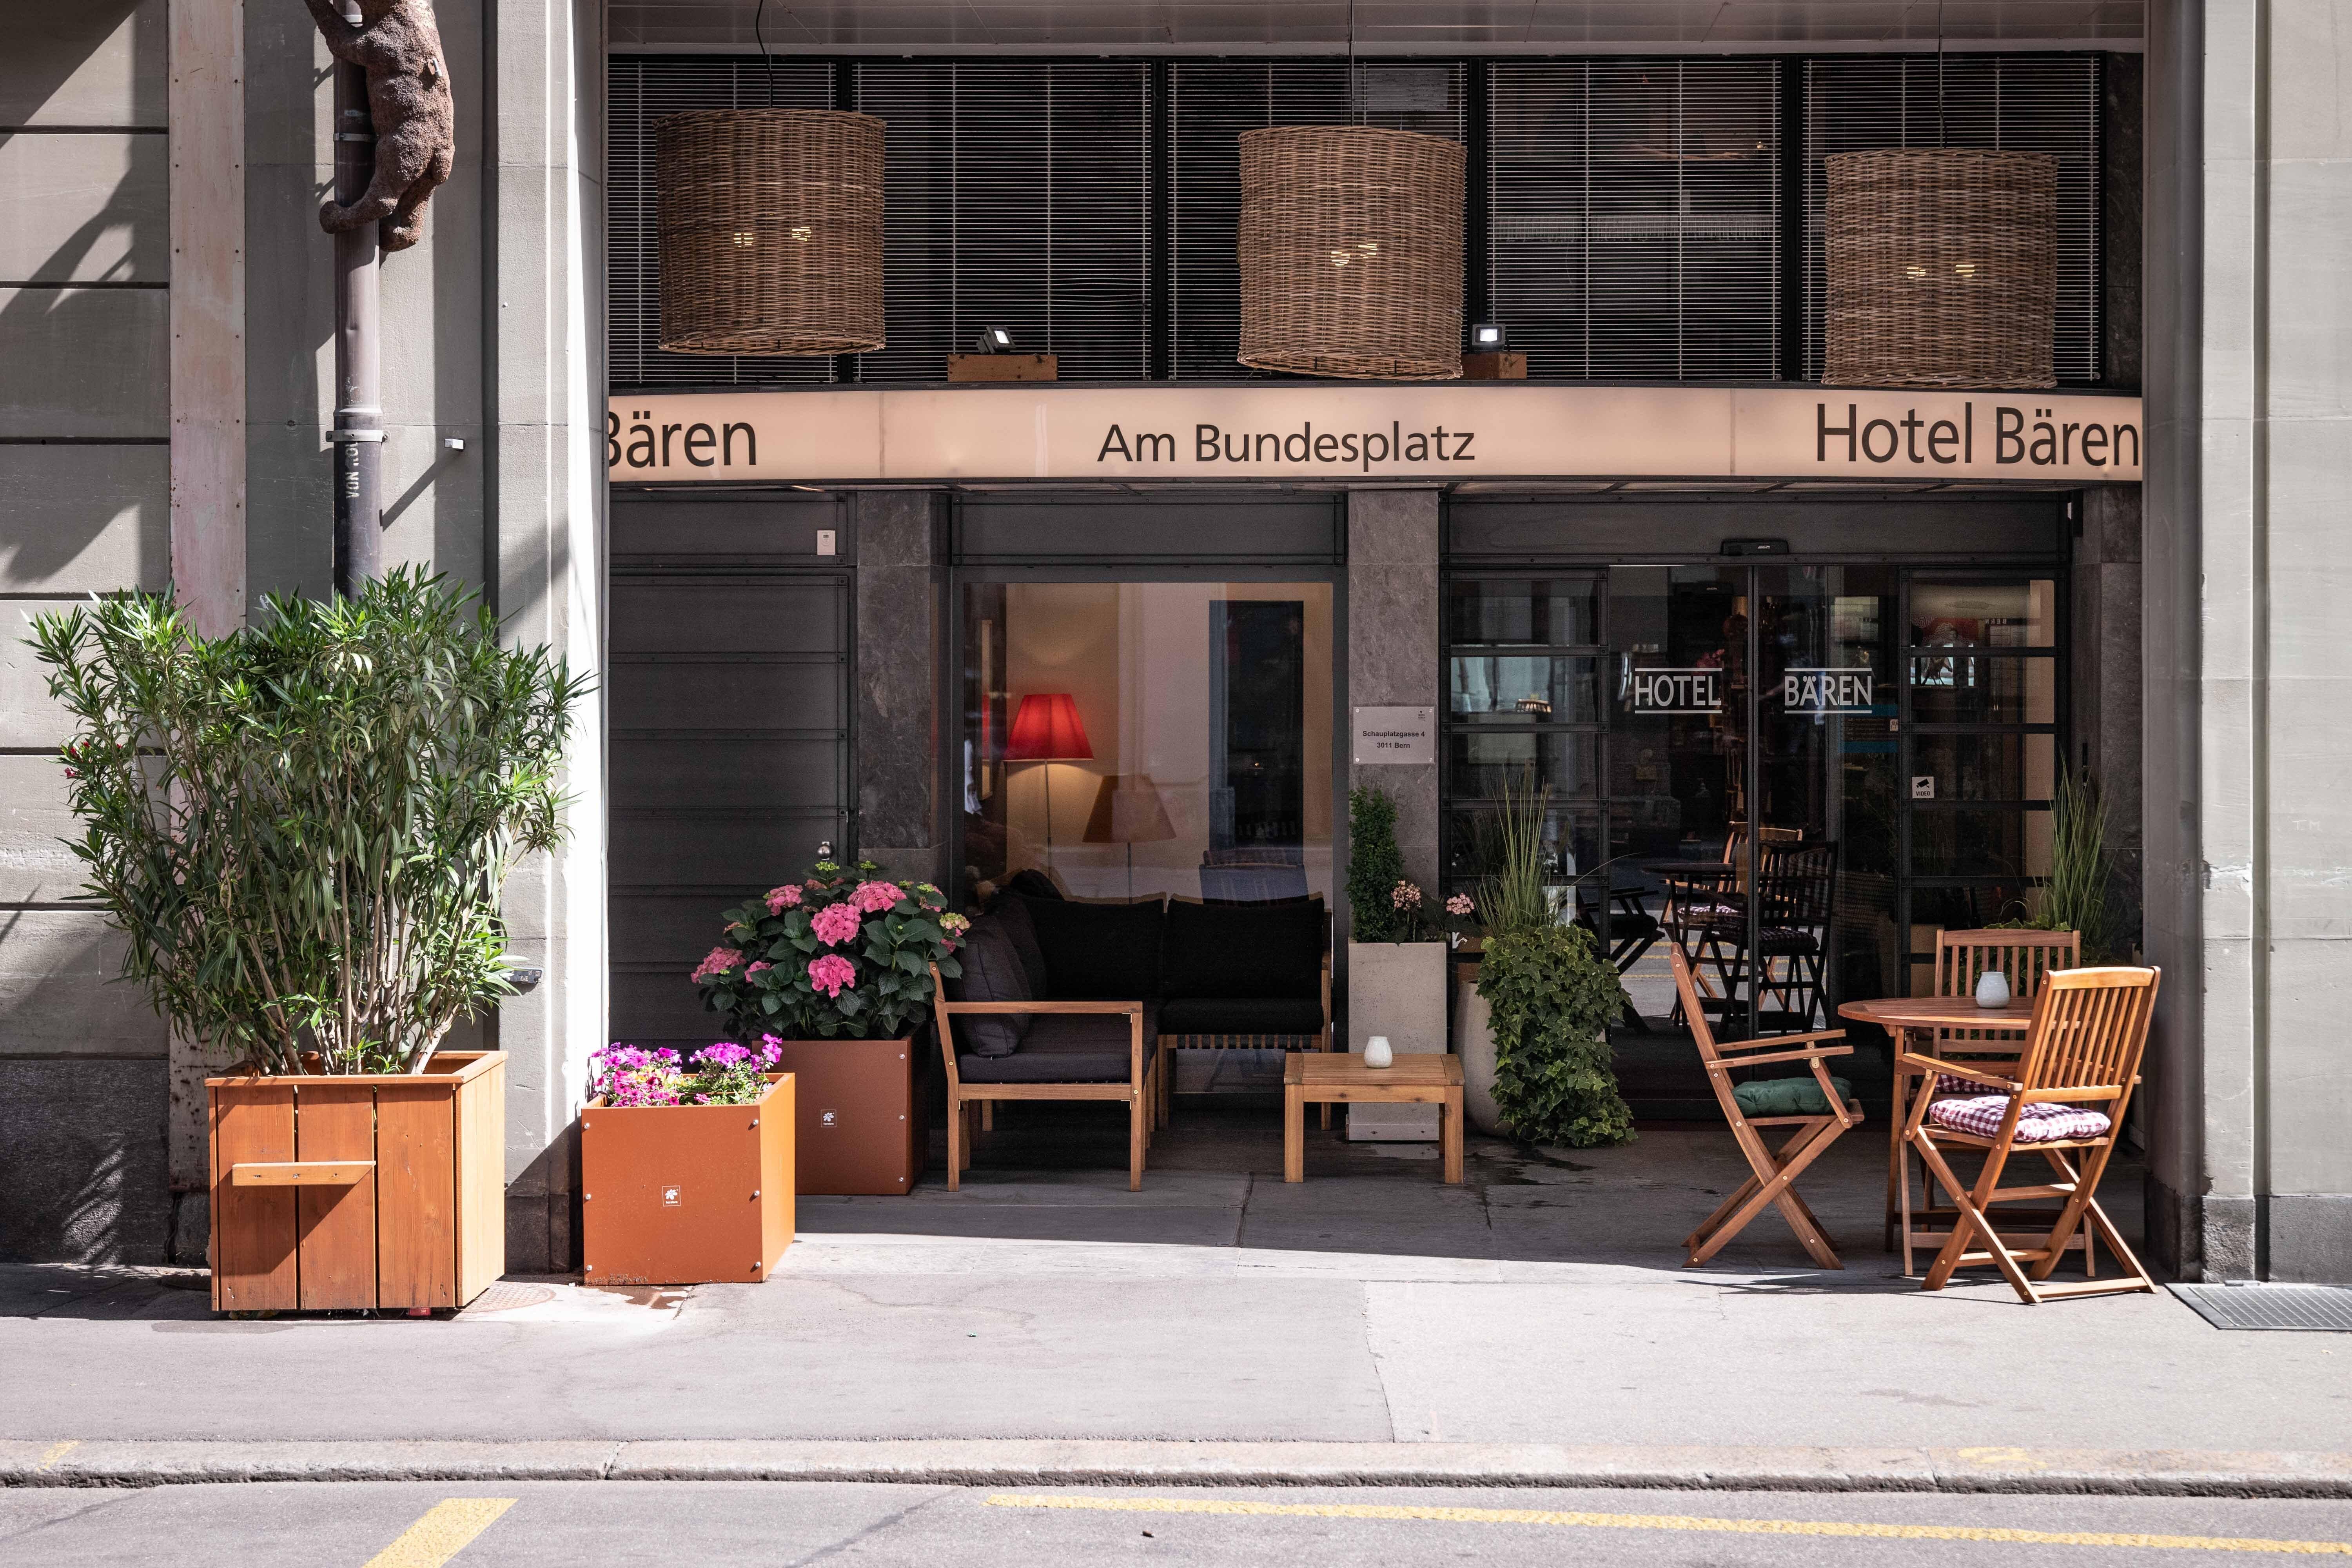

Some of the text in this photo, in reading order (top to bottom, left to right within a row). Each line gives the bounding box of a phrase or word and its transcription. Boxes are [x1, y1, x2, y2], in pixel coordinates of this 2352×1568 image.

[1097, 421, 1475, 472] Am Bundesplatz
[1817, 402, 2139, 466] Hotel Bären
[1635, 675, 1872, 706] HOTEL BÄREN
